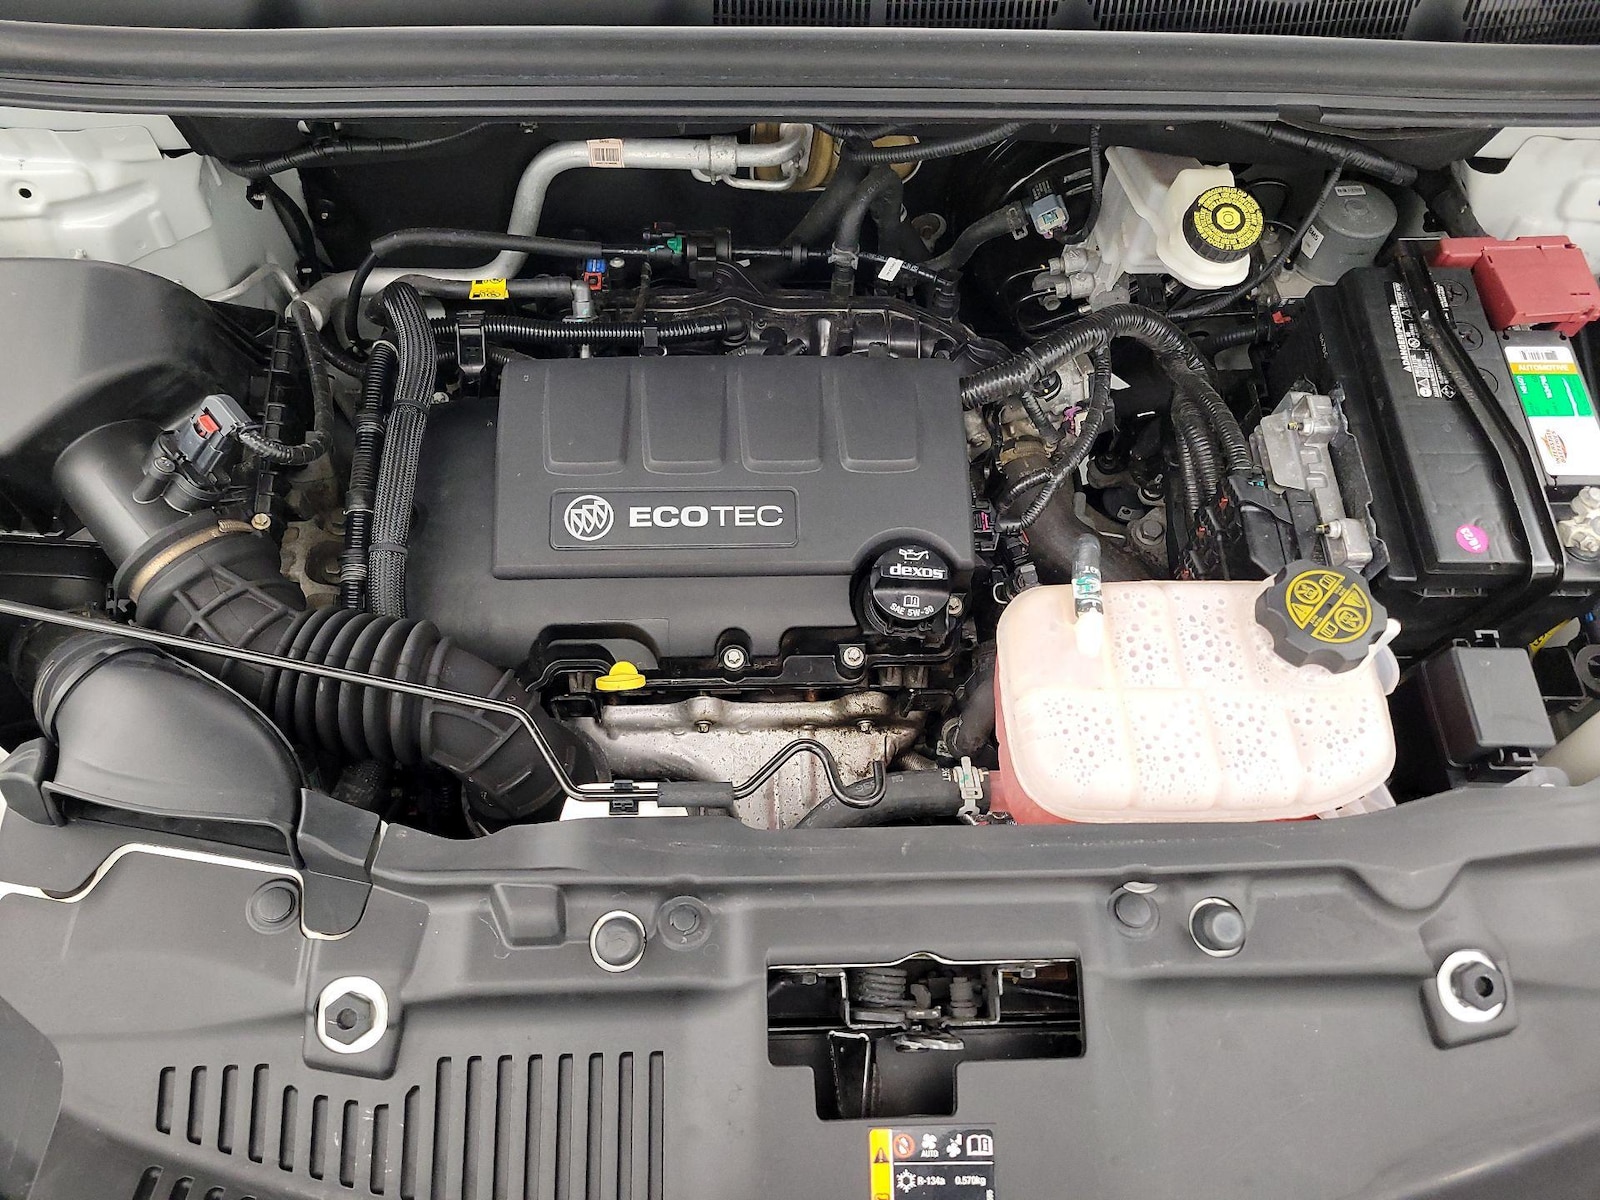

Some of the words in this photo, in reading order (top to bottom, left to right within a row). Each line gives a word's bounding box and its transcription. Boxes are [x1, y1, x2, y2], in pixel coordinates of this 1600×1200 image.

[1390, 304, 1410, 366] DANGER/POISON
[1518, 364, 1569, 372] AUTOMOTIVE
[629, 505, 784, 528] ECOTEC
[889, 563, 946, 579] dexos
[890, 602, 905, 615] SAE
[907, 605, 934, 617] 5W-30
[920, 1149, 940, 1158] AUTO
[916, 1175, 946, 1186] R-134a
[954, 1175, 987, 1187] 0.570kg
